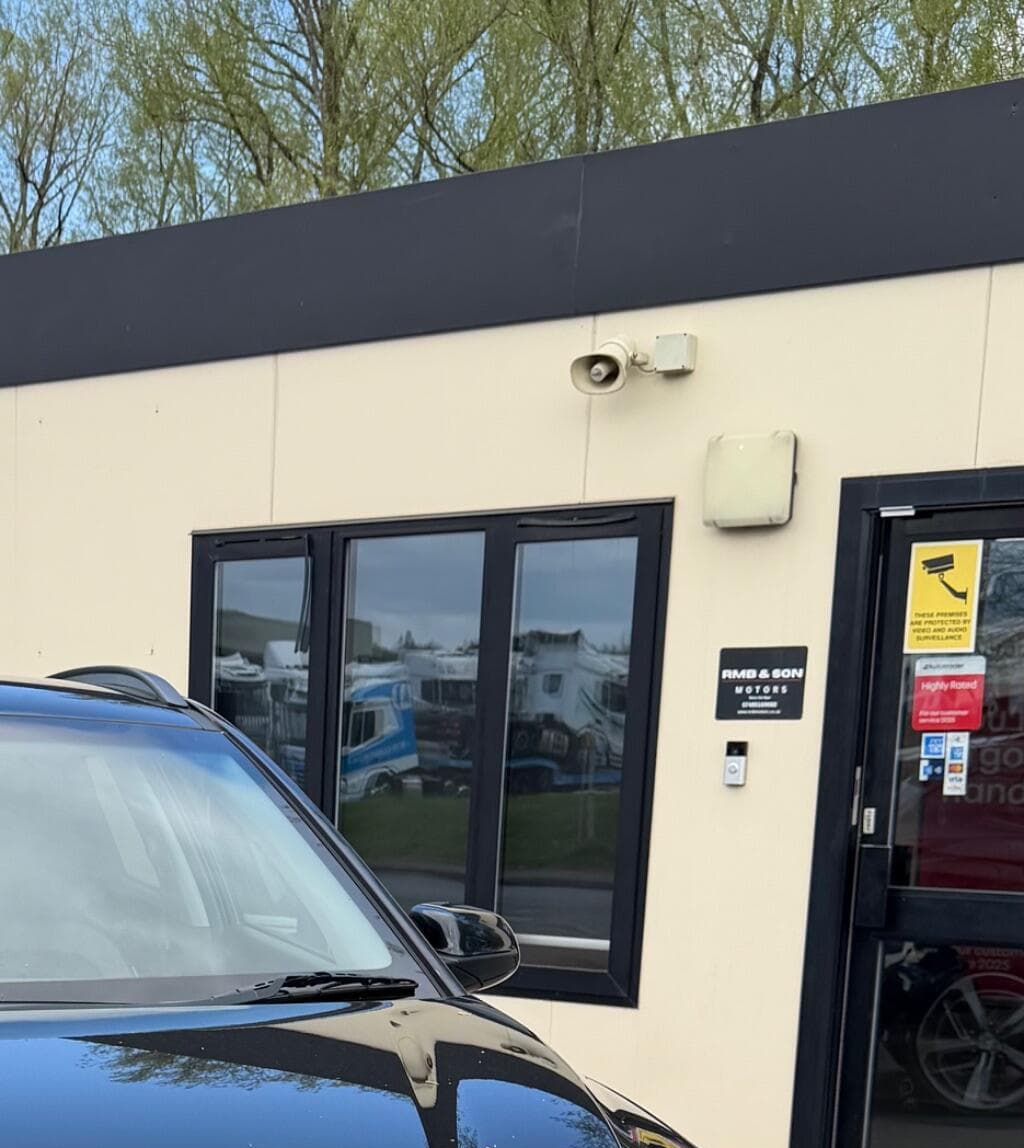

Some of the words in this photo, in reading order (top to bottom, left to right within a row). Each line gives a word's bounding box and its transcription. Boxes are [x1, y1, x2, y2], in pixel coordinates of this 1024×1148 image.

[721, 669, 757, 679] RMB
[758, 669, 770, 678] &
[771, 668, 804, 678] SON
[734, 685, 788, 694] MOTORS
[921, 681, 949, 692] Highly
[950, 680, 977, 690] Rated
